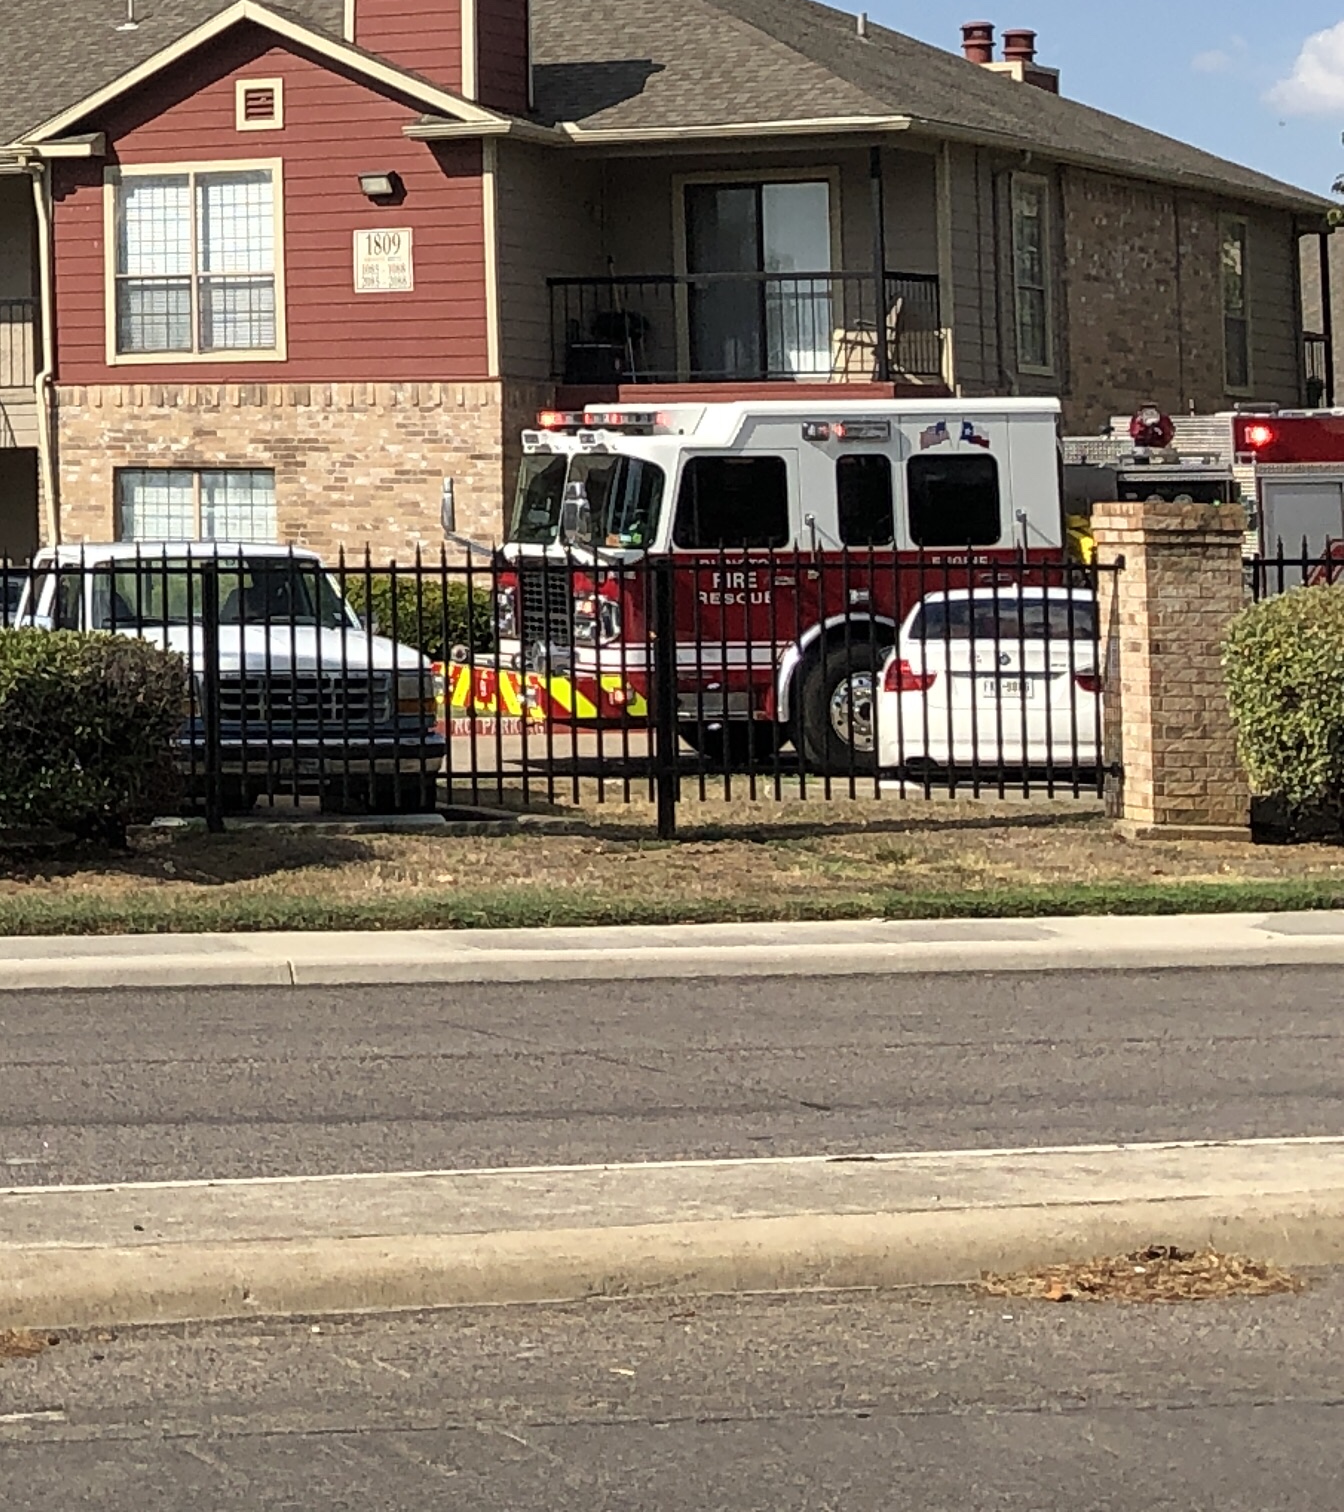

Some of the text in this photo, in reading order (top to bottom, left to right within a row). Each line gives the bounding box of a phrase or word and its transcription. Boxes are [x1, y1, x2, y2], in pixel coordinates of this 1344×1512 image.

[365, 232, 401, 255] 1809
[713, 572, 757, 589] FIRE
[699, 591, 771, 605] RESCUE
[481, 717, 545, 736] PARKNG
